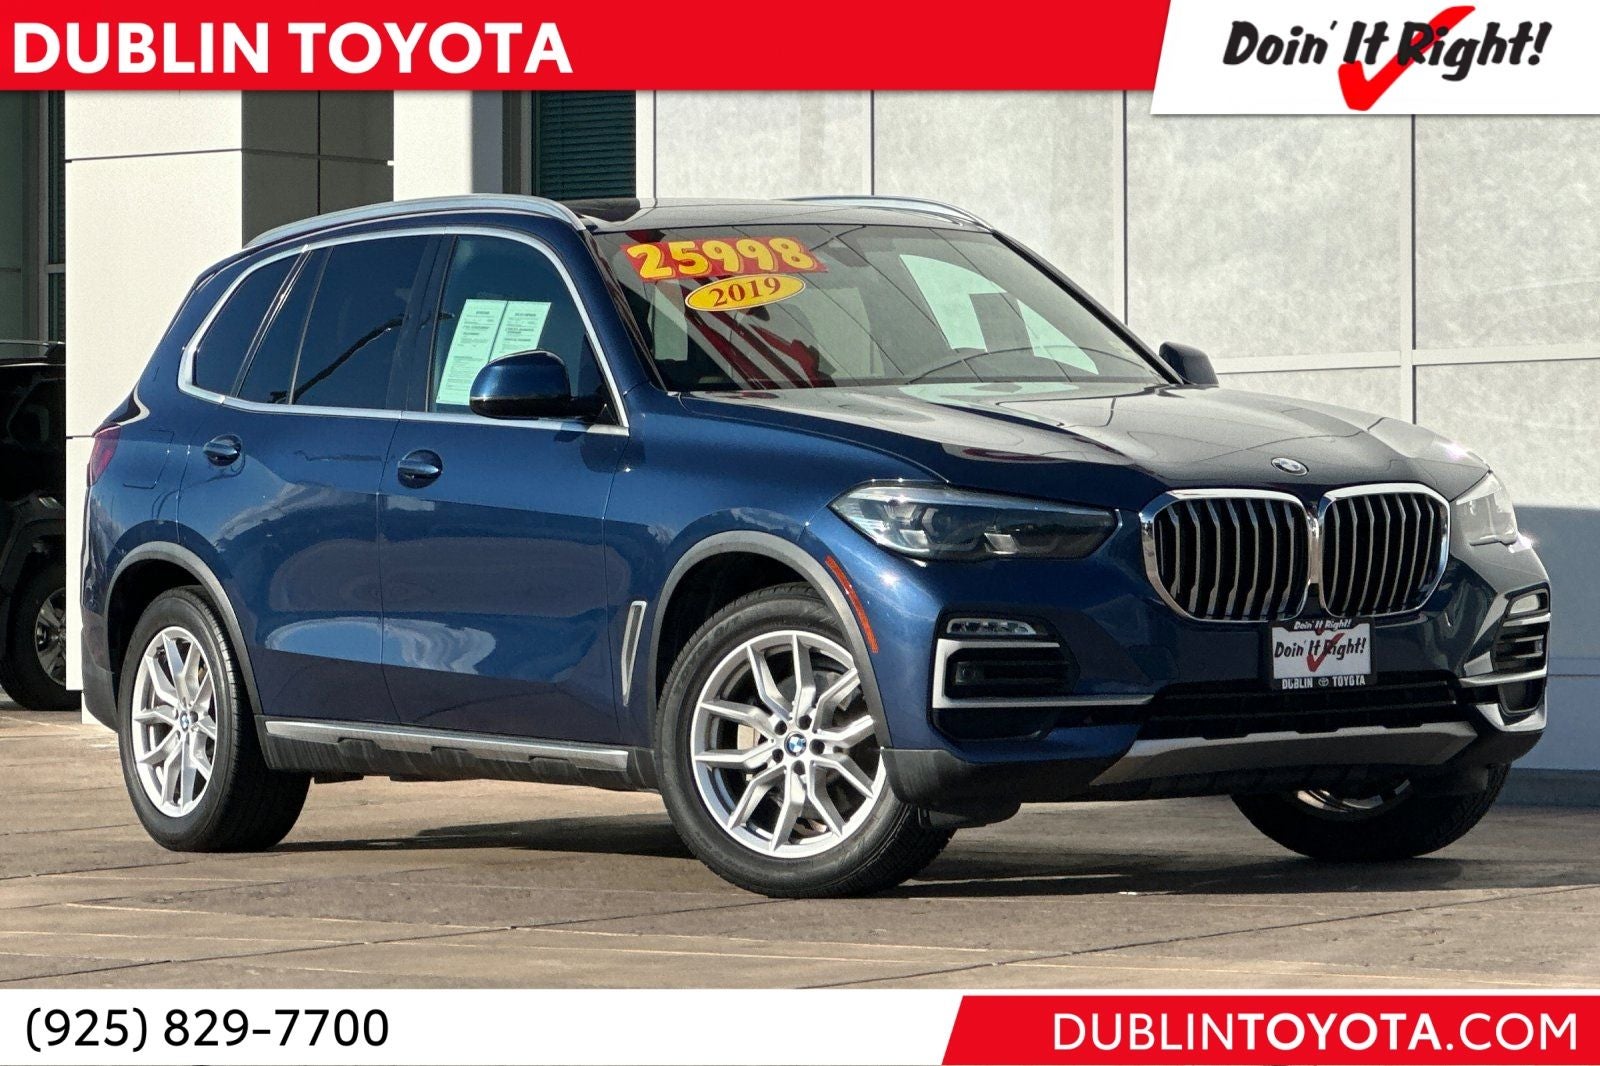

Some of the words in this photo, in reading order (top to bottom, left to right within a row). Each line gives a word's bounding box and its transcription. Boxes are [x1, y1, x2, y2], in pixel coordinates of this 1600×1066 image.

[626, 237, 816, 279] 25998
[709, 276, 782, 308] 2019
[1308, 639, 1321, 656] It
[1323, 637, 1367, 660] Right!
[1282, 677, 1313, 689] DUBLIN
[1332, 675, 1366, 687] TOYOTA
